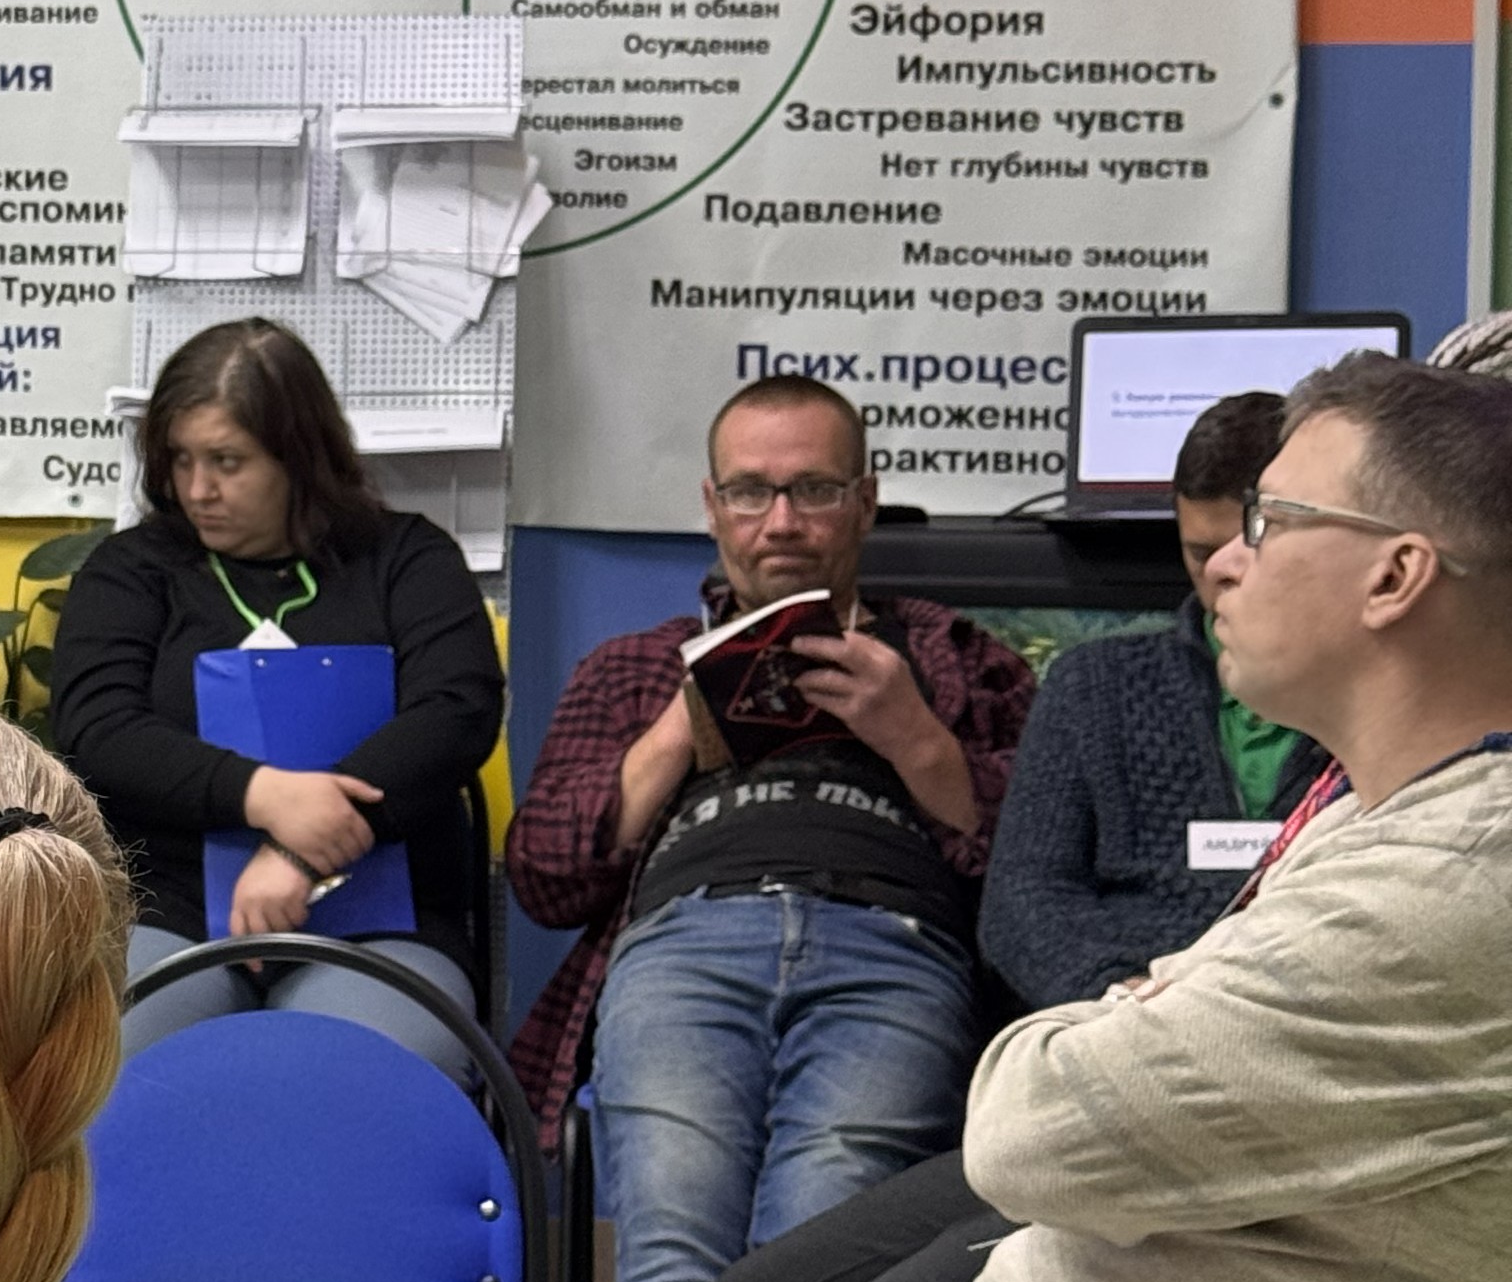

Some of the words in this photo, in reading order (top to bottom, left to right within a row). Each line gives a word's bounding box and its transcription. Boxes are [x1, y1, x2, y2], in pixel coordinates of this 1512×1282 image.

[670, 3, 686, 17] и
[851, 4, 1043, 42] Эйфория
[624, 34, 770, 58] Осуждение
[522, 77, 614, 96] ерестал
[623, 79, 740, 94] молиться
[898, 55, 1216, 90] Импульсивность
[521, 115, 683, 132] есценивание
[784, 102, 1040, 138] Застревание
[1054, 110, 1184, 139] чувств
[574, 148, 677, 172] Эгоизм
[881, 153, 938, 177] Нет
[951, 151, 1088, 183] глубины
[1100, 159, 1209, 184] чувств
[551, 192, 628, 208] волие
[705, 194, 942, 227] Подавление
[903, 241, 1072, 267] Масочные
[1084, 247, 1208, 272] эмоции
[0, 276, 115, 307] Трудно
[651, 279, 914, 315] Манипуляции
[930, 289, 1043, 317] через
[1057, 286, 1207, 316] эмоции
[736, 345, 1067, 386] Псих.процес
[862, 402, 1070, 431] рможенно
[43, 455, 122, 485] Судо
[871, 450, 1066, 477] рактивно
